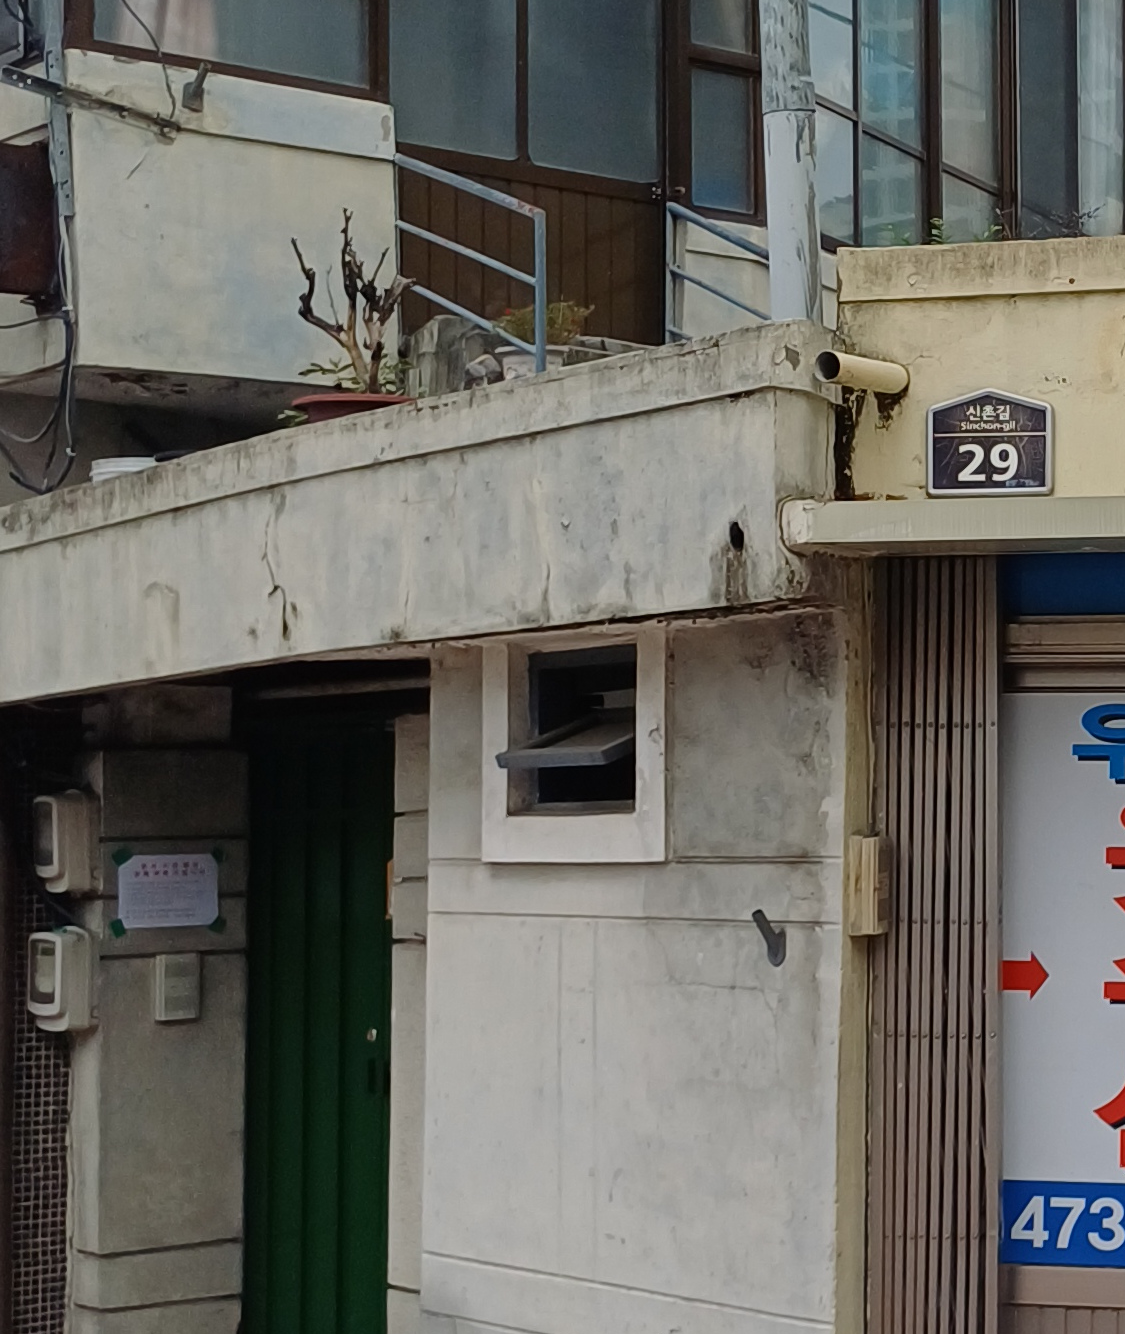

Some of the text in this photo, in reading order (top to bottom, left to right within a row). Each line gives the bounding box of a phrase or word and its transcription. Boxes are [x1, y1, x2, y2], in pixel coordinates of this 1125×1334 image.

[965, 404, 1011, 421] 신촌길
[960, 420, 1017, 432] Sinchon-gil
[957, 442, 1019, 482] 29
